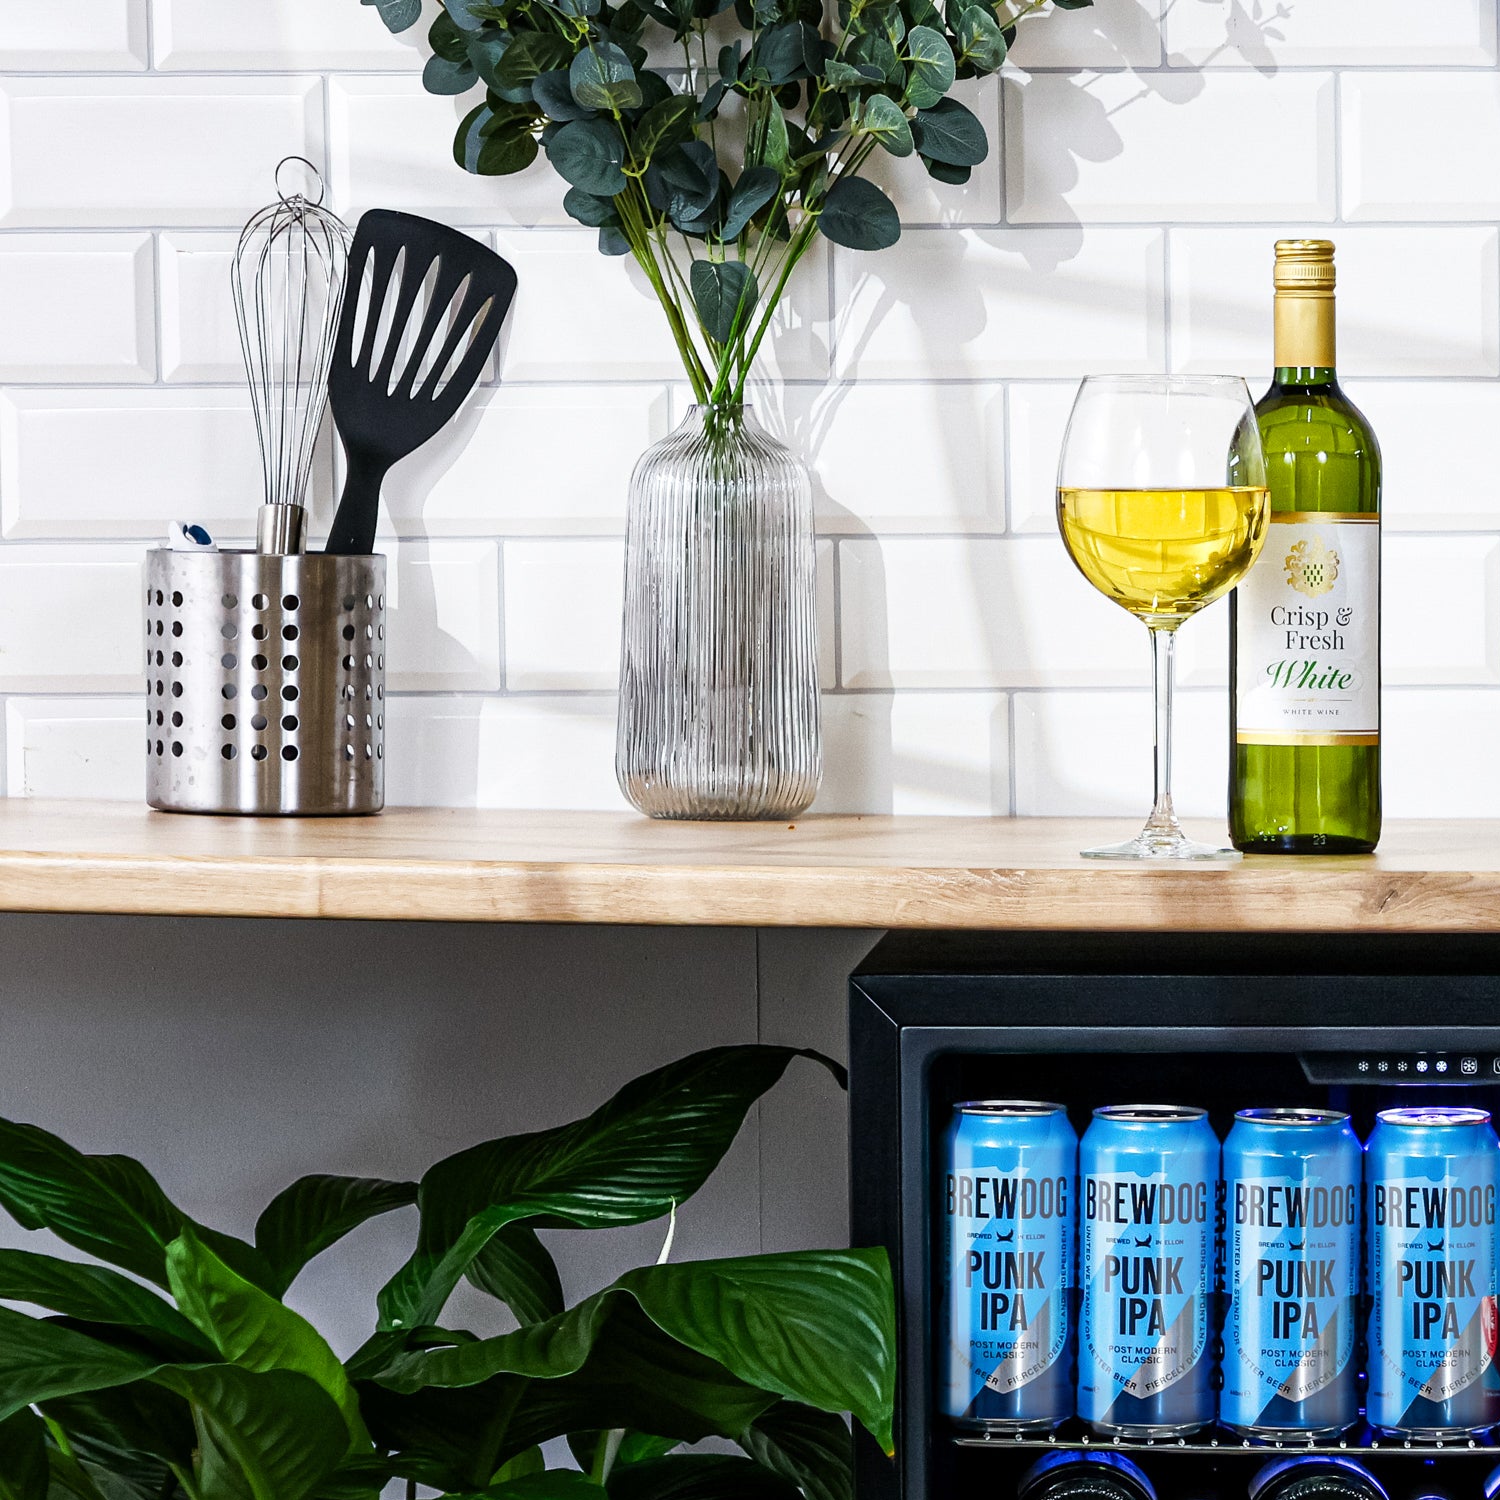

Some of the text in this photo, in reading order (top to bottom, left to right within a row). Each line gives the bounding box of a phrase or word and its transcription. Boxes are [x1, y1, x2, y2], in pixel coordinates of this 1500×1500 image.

[1271, 606, 1353, 630] Crisp &
[1285, 629, 1344, 650] Fresh
[1266, 659, 1354, 690] White
[946, 1175, 1068, 1220] BREWDOG
[1086, 1178, 1207, 1224] BREWDOG
[1235, 1183, 1355, 1228] BREWDOG
[1375, 1184, 1495, 1229] BREWDOG
[966, 1250, 1046, 1290] PUNK
[1105, 1255, 1184, 1295] PUNK
[1256, 1259, 1335, 1298] PUNK
[1396, 1260, 1476, 1298] PUNK
[980, 1293, 1028, 1331] IPA
[1119, 1298, 1166, 1336] IPA
[1272, 1301, 1319, 1340] IPA
[1413, 1302, 1460, 1340] IPA
[970, 1341, 1039, 1350] POST MODERN
[983, 1350, 1025, 1360] CLASSIC
[1108, 1345, 1177, 1355] POST MODERN
[1121, 1355, 1163, 1365] CLASSIC
[1261, 1349, 1330, 1359] POST MODERN
[1274, 1359, 1316, 1368] CLASSIC
[1402, 1349, 1471, 1359] POST MODERN
[1416, 1359, 1458, 1368] CLASSIC
